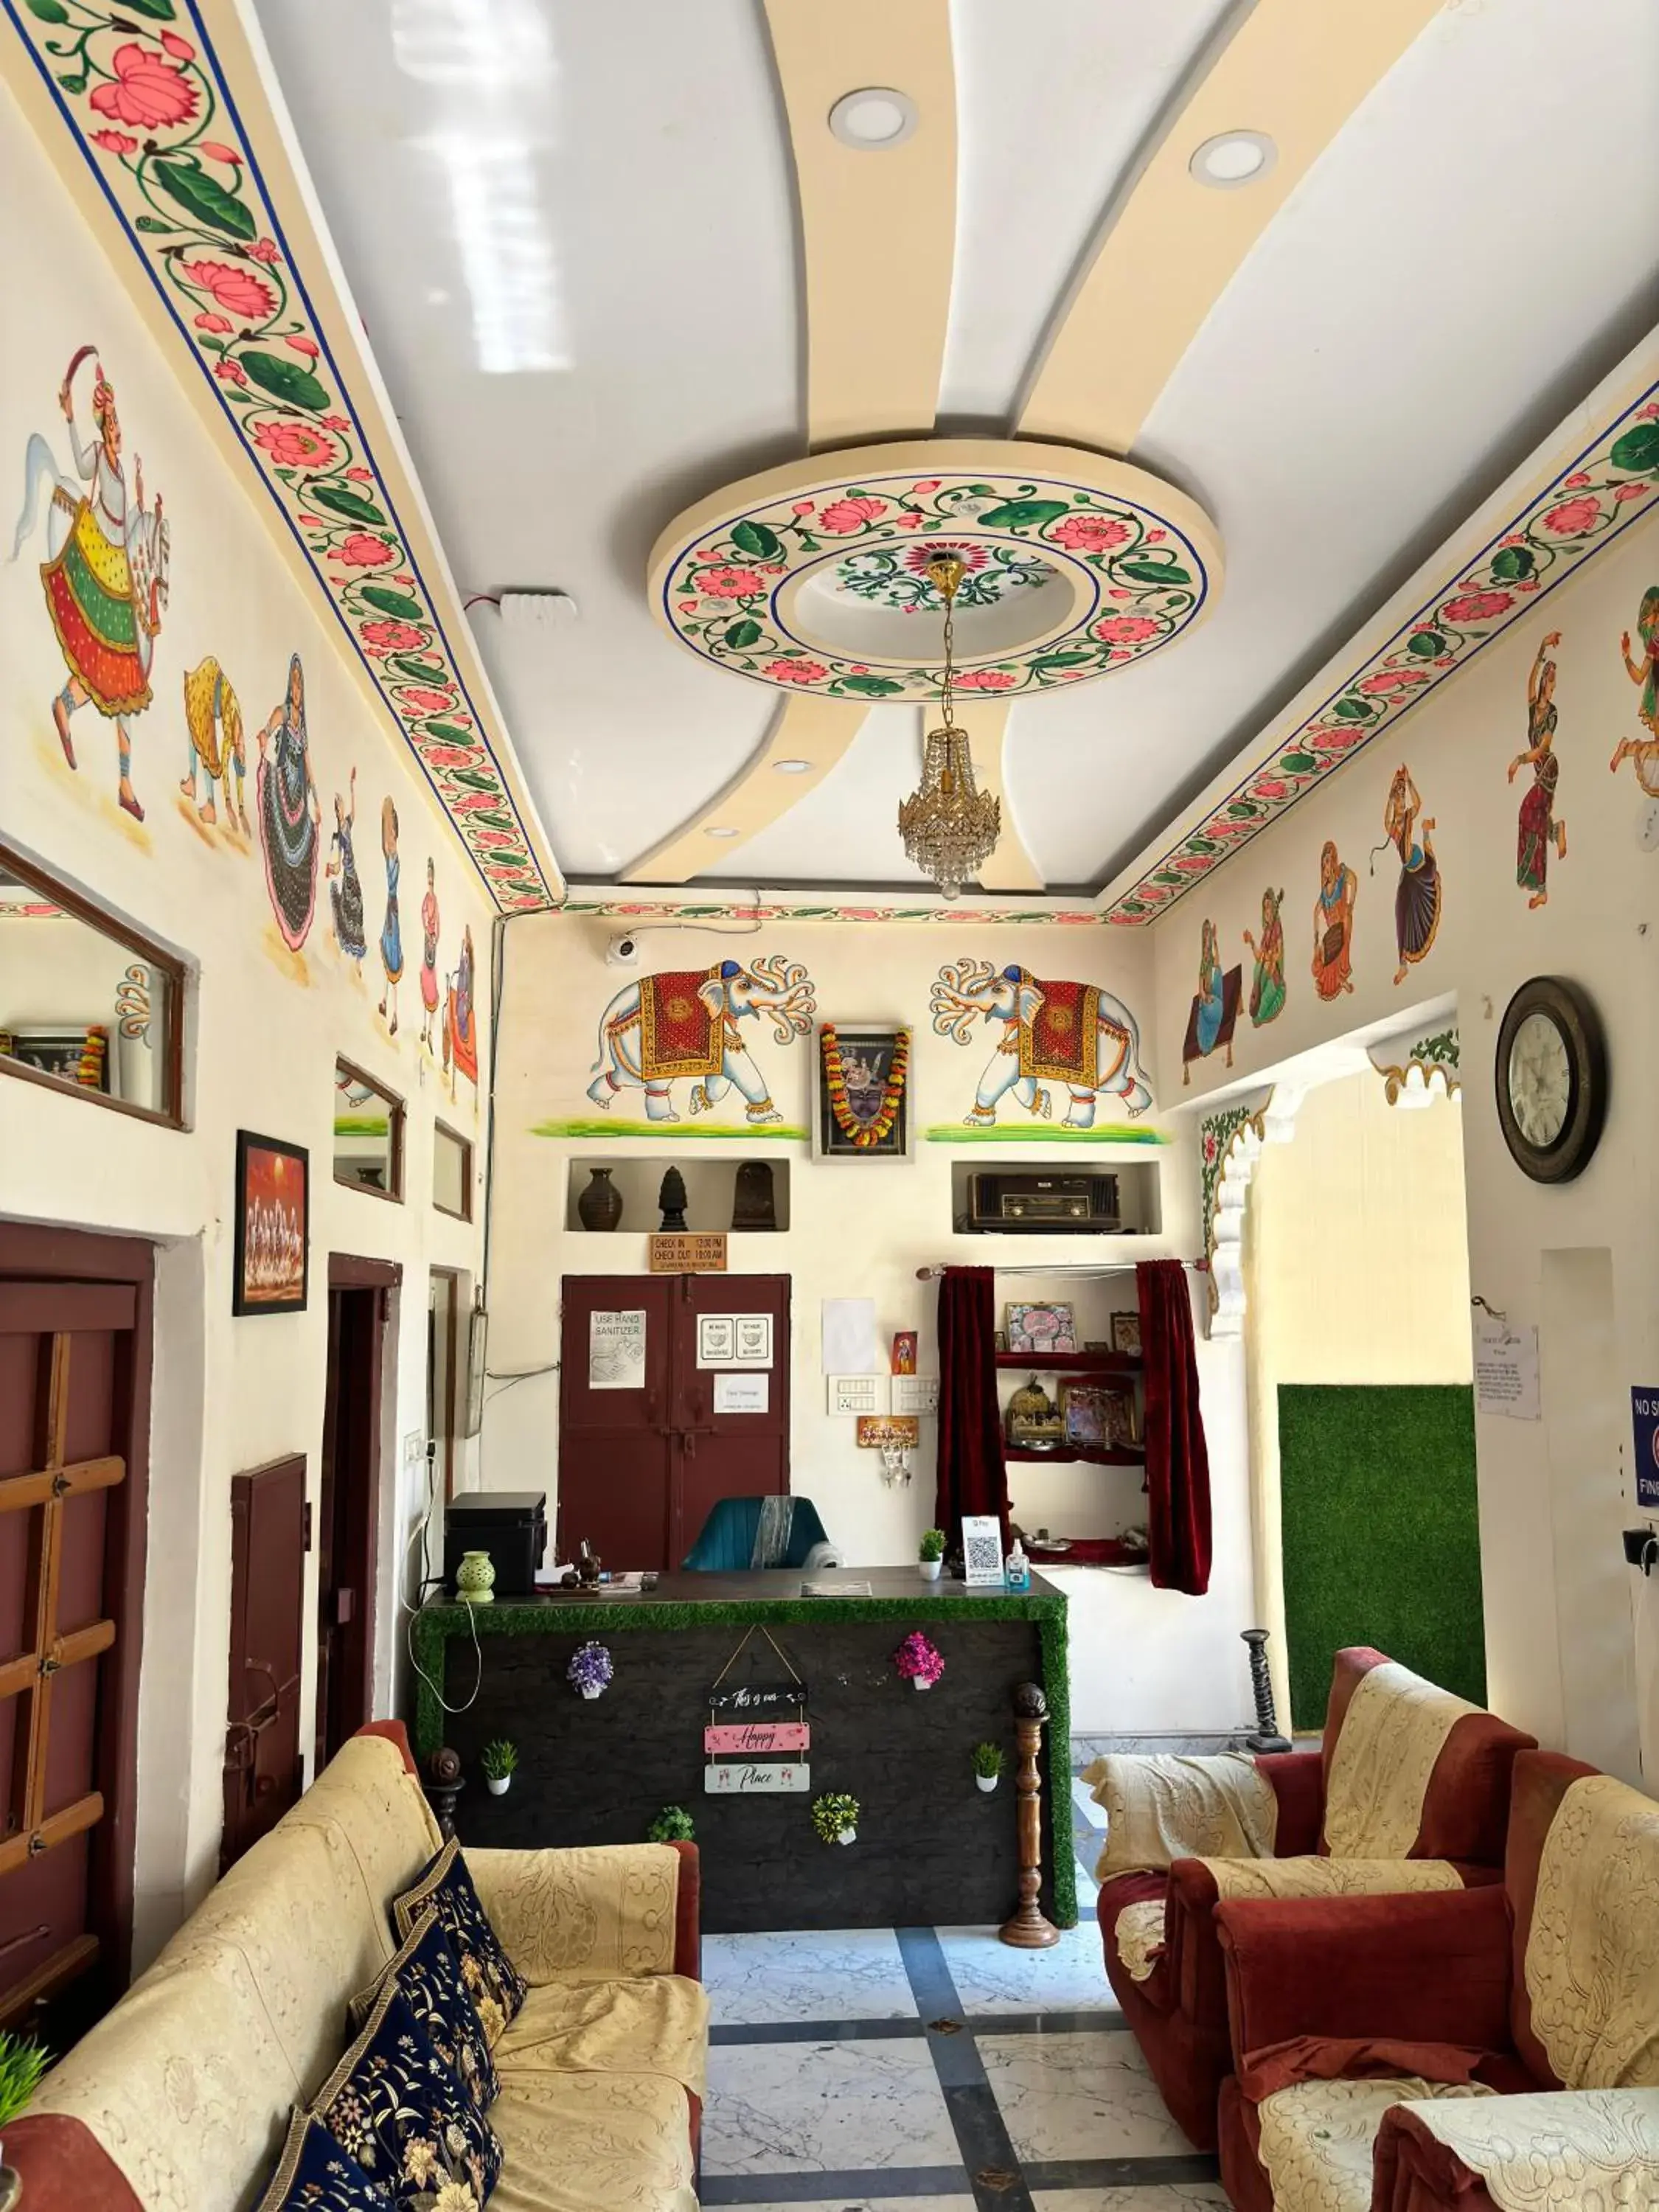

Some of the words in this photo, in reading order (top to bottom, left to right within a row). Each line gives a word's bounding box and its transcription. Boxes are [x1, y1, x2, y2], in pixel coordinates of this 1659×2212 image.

[654, 1251, 675, 1260] CHECK
[678, 1250, 691, 1260] OUT
[595, 1315, 613, 1324] USE
[615, 1315, 639, 1324] HAND
[595, 1326, 639, 1335] SANITIZER
[1635, 1399, 1649, 1416] NO
[1651, 1400, 1659, 1416] S
[737, 1725, 776, 1750] Happy
[738, 1764, 772, 1790] Place
